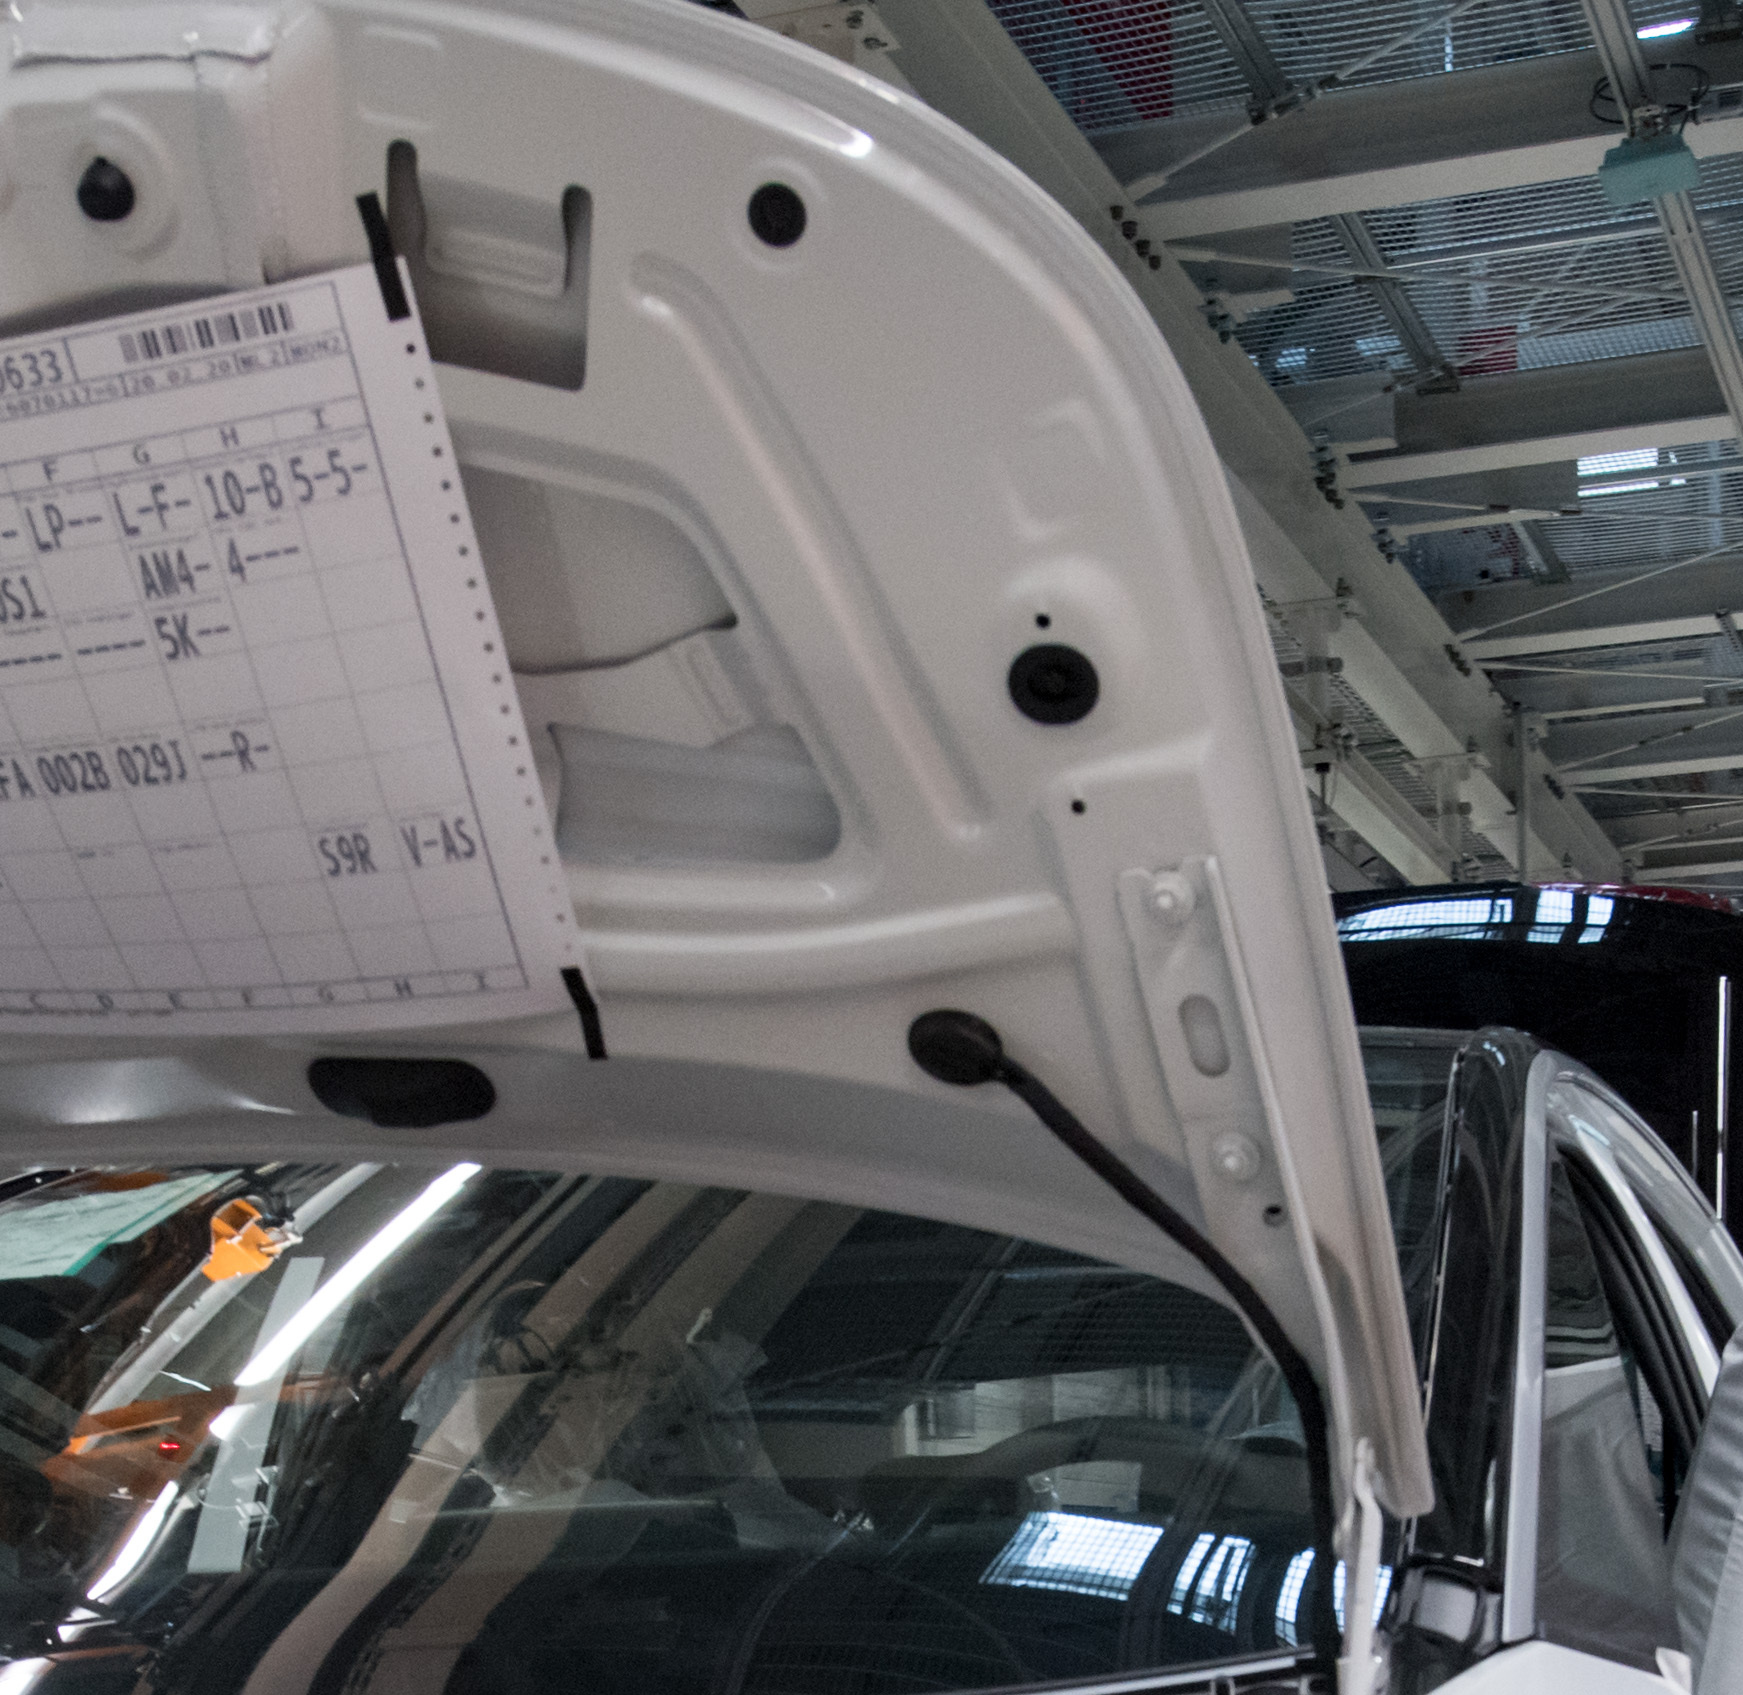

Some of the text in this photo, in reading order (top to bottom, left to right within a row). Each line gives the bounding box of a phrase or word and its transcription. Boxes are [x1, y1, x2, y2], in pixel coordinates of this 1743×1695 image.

[42, 459, 59, 482] F
[132, 442, 151, 466] G
[218, 425, 241, 447] H
[25, 502, 103, 552] LP--
[112, 481, 192, 537] L-F-
[205, 460, 283, 521] 10-B
[288, 448, 368, 503] 5-5-
[154, 612, 231, 660] 5K--
